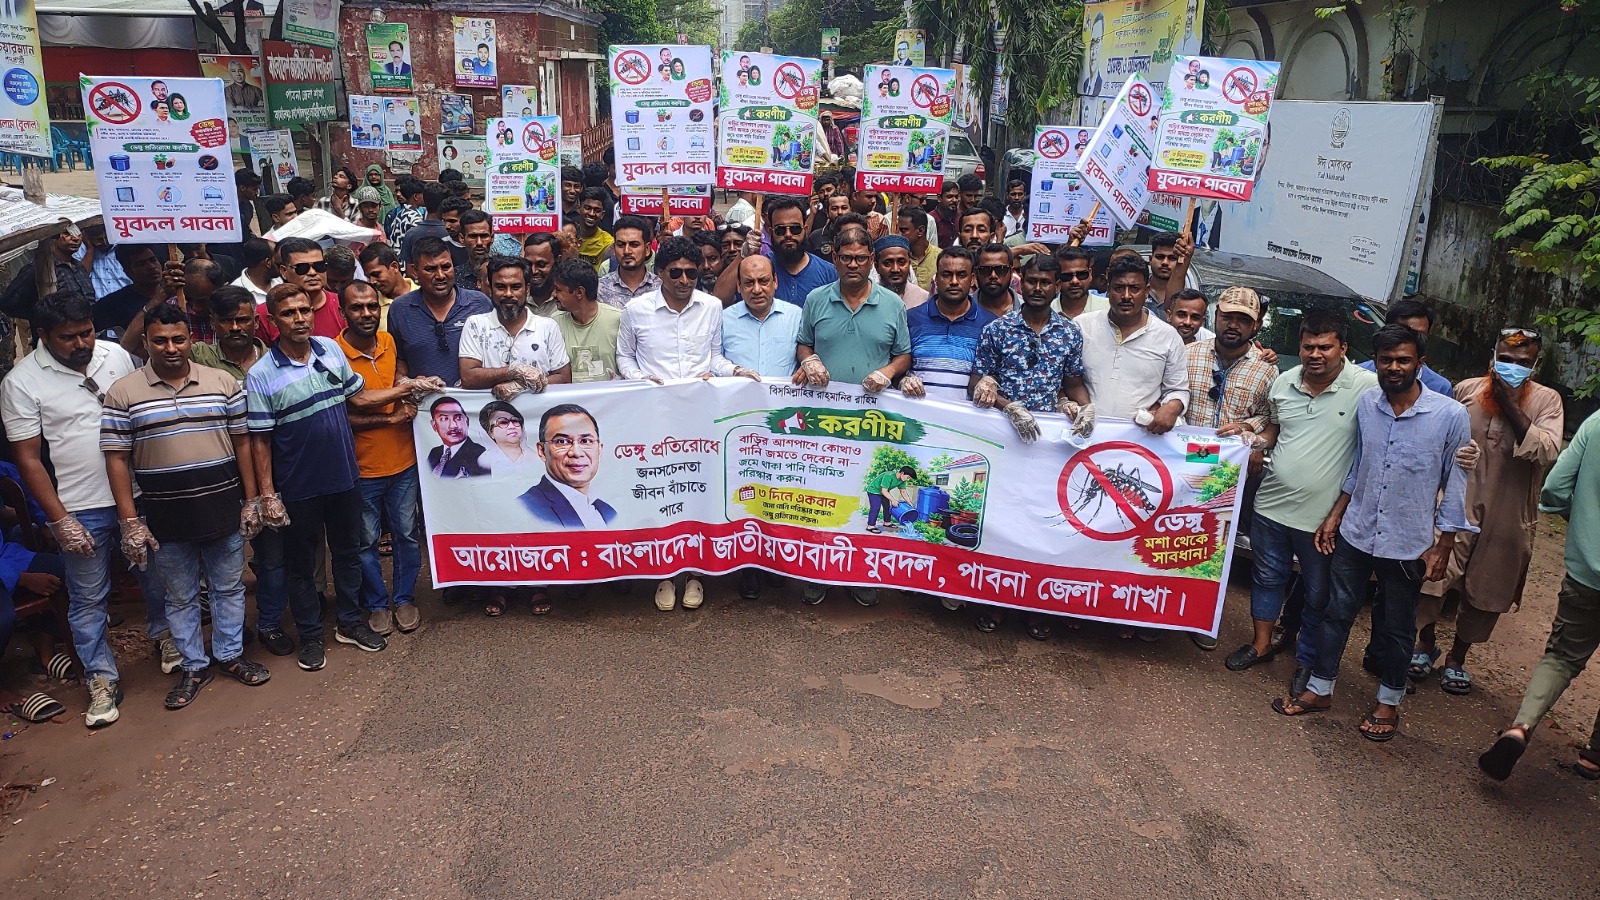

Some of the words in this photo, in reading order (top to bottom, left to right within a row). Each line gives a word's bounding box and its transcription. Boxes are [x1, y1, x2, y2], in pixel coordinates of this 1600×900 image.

[755, 107, 786, 121] করণীয়
[894, 114, 921, 127] করণীয়
[1199, 111, 1232, 125] করণীয়
[511, 160, 534, 172] করণীয়
[622, 162, 667, 181] যুবদল
[671, 161, 711, 175] পাবনা
[724, 169, 766, 186] যুবদল
[768, 172, 806, 188] পাবনা
[863, 174, 901, 189] যুবদল
[903, 175, 937, 188] পাবনা
[1156, 172, 1202, 189] যুবদল
[1204, 179, 1246, 194] পাবনা
[1086, 158, 1114, 193] যুবদল
[1112, 189, 1137, 219] পাবনা
[628, 196, 663, 212] যুবদল
[669, 196, 703, 209] পাবনা
[112, 217, 174, 238] যুবদল
[180, 217, 234, 231] পাবনা
[492, 216, 522, 231] যুবদল
[524, 216, 552, 227] পাবনা
[1032, 223, 1071, 238] যুবদল
[855, 394, 878, 405] রাহিম
[817, 410, 905, 441] করণীয়
[614, 439, 647, 462] ডেঙ্গু
[652, 436, 721, 458] প্রতিরোধে
[739, 433, 769, 445] বাড়ির
[772, 438, 818, 451] আশপাশে
[822, 443, 862, 456] কোথাও
[739, 445, 762, 456] পানি
[765, 449, 798, 460] জমতে
[802, 453, 834, 464] দেবেন
[636, 461, 701, 480] জনসচেনতা
[738, 458, 759, 467] জমে
[761, 461, 782, 470] থাকা
[785, 461, 805, 473] পানি
[808, 464, 845, 478] নিয়মিত
[632, 483, 664, 501] জীবন
[668, 480, 707, 494] বাঁচাতে
[759, 488, 766, 498] ৩
[769, 487, 794, 502] দিনে
[796, 493, 837, 509] একবার
[659, 502, 683, 517] পারে
[1154, 512, 1206, 533] ডেঙ্গু
[1144, 536, 1171, 550] মশা
[1174, 533, 1209, 547] থেকে
[1152, 547, 1208, 565] সাবধান!
[450, 544, 571, 573] আয়োজনে
[594, 531, 706, 569] বাংলাদেশ
[710, 521, 860, 572] জাতীয়তাবাদী
[957, 561, 1031, 599] পাবনা
[1038, 576, 1105, 608] জেলা
[1110, 584, 1172, 615] শাখা
